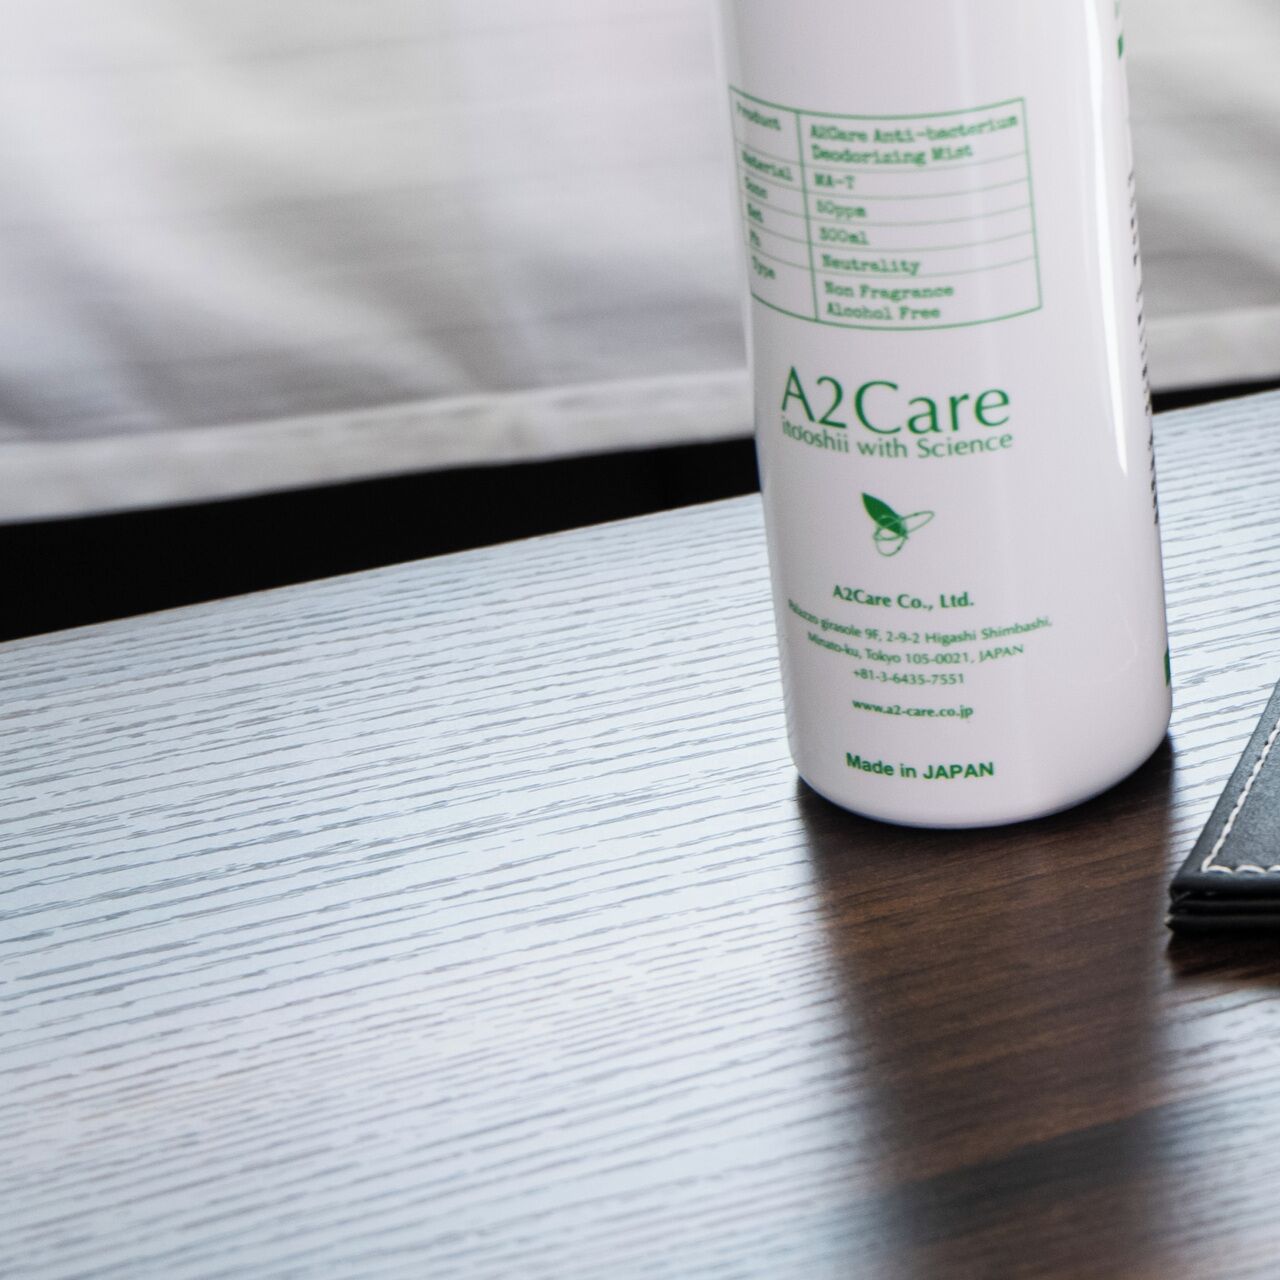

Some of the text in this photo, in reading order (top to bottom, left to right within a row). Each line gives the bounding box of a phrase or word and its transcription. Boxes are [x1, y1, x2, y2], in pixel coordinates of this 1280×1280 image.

[930, 144, 973, 161] Mist
[822, 254, 920, 276] Neutrality
[824, 280, 954, 302] Non Fragrance
[826, 302, 941, 320] Alcohol Free
[781, 366, 1010, 435] A2Care
[857, 437, 908, 458] with
[917, 433, 1013, 459] Science
[833, 584, 975, 611] A2Care Co., Ltd.
[886, 630, 920, 644] 2-9-2
[925, 629, 977, 647] Higashi
[865, 648, 902, 665] Tokyo
[906, 651, 975, 665] 105-0021,
[979, 644, 1024, 664] JAPAN
[853, 668, 965, 686] +81-3-6435-7551
[852, 699, 974, 719] www.a2-care.co.jp
[846, 751, 994, 780] Made in JAPAN
